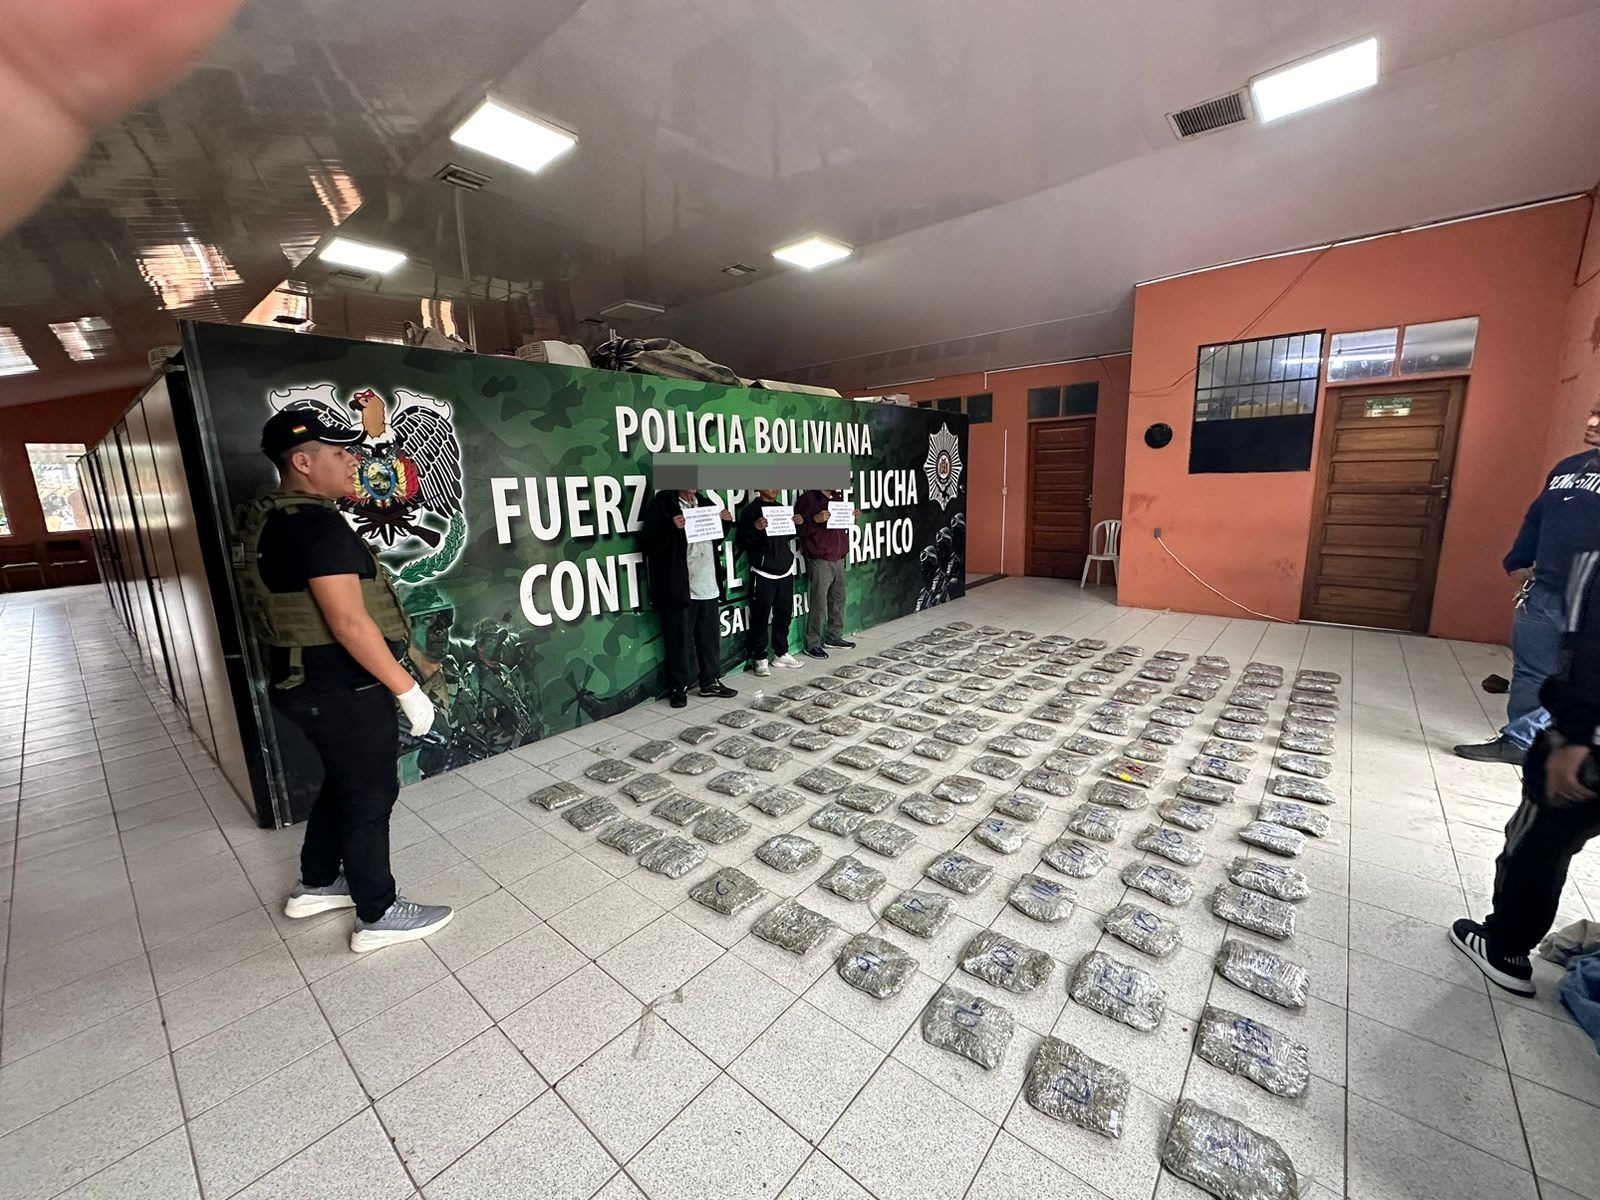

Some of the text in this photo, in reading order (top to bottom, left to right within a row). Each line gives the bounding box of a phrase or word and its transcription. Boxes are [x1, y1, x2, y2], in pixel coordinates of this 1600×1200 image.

[615, 405, 872, 457] POLICIA BOLIVIANA
[491, 474, 646, 545] FUERZ
[860, 469, 918, 510] LUCHA
[519, 552, 643, 627] CONT
